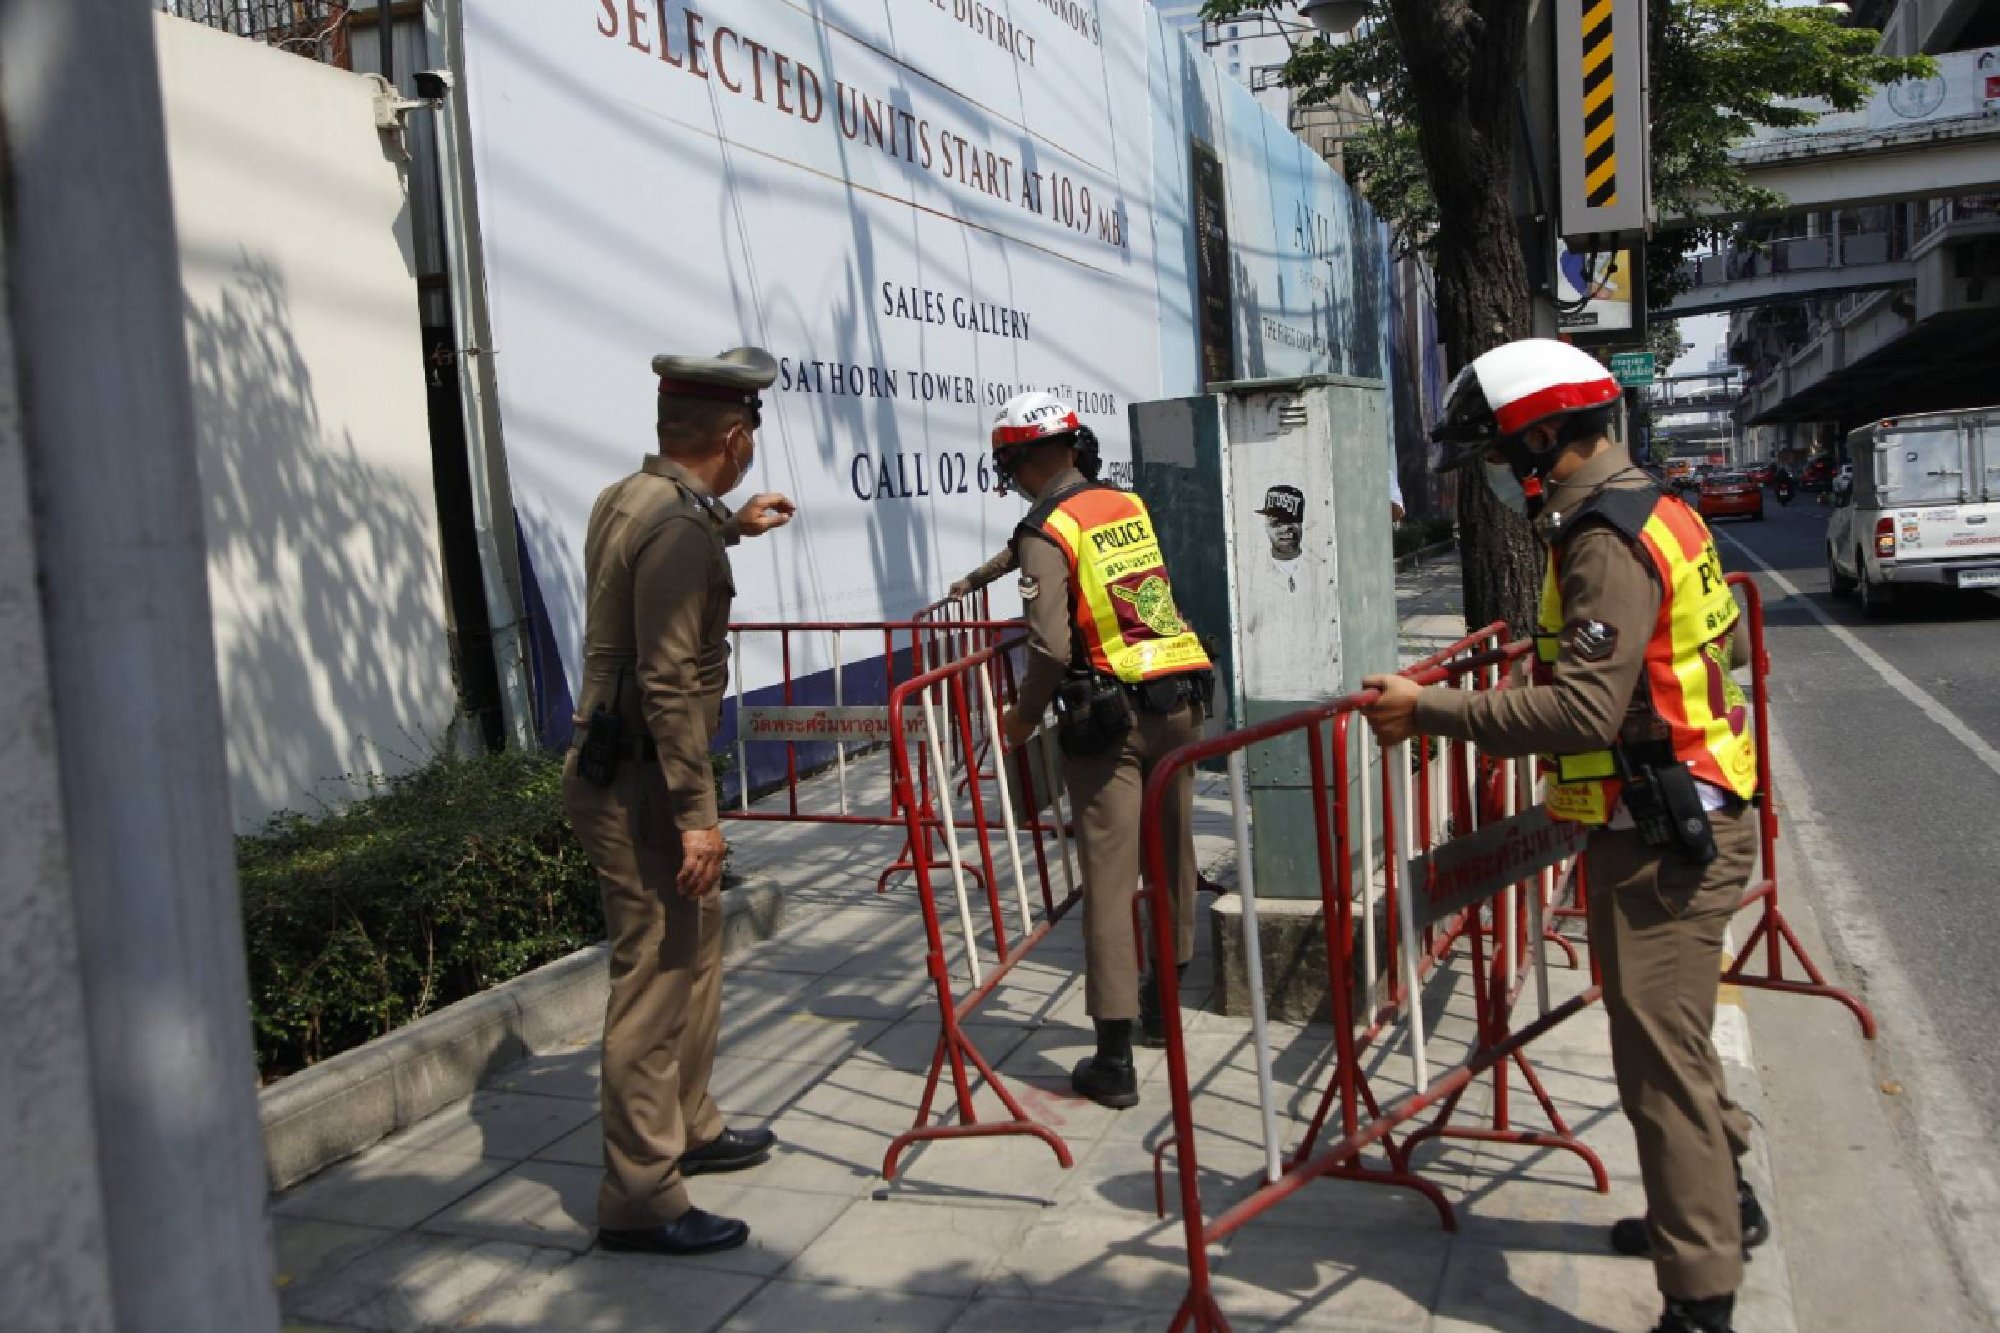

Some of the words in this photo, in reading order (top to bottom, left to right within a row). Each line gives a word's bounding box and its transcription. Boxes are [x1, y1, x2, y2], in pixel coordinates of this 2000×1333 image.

[954, 0, 1035, 67] DISTRICT
[833, 80, 933, 169] UNITS
[941, 130, 1013, 202] START
[1021, 168, 1044, 216] AT
[1050, 171, 1092, 234] 10.9
[882, 281, 947, 326] SALES
[953, 297, 1031, 341] GALLERY
[780, 356, 898, 400] SATHORN
[907, 370, 977, 405] TOWER
[1076, 390, 1118, 416] FLOOR
[851, 452, 929, 501] CALL
[939, 452, 968, 495] 02
[1091, 519, 1150, 554] POLICE
